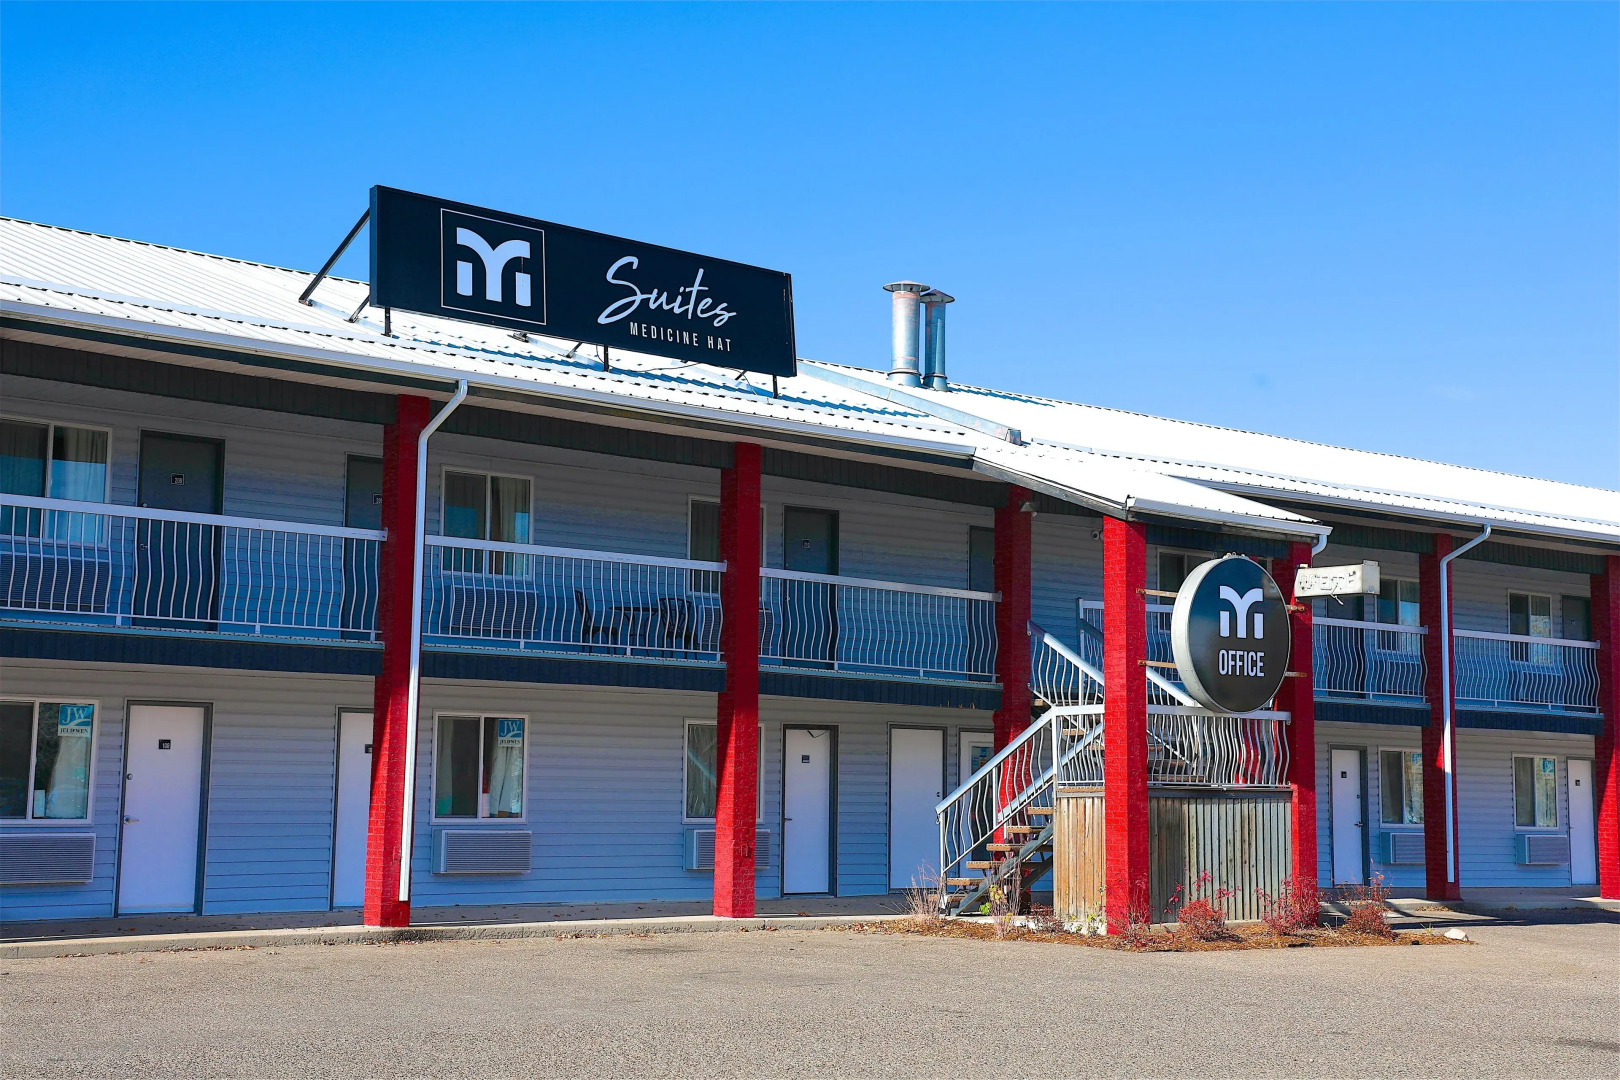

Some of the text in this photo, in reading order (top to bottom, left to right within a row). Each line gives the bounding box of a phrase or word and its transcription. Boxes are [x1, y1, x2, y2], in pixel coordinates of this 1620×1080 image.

[597, 255, 737, 327] Suites
[629, 321, 731, 352] MEDICINE HAT
[1218, 649, 1265, 678] OFFICE
